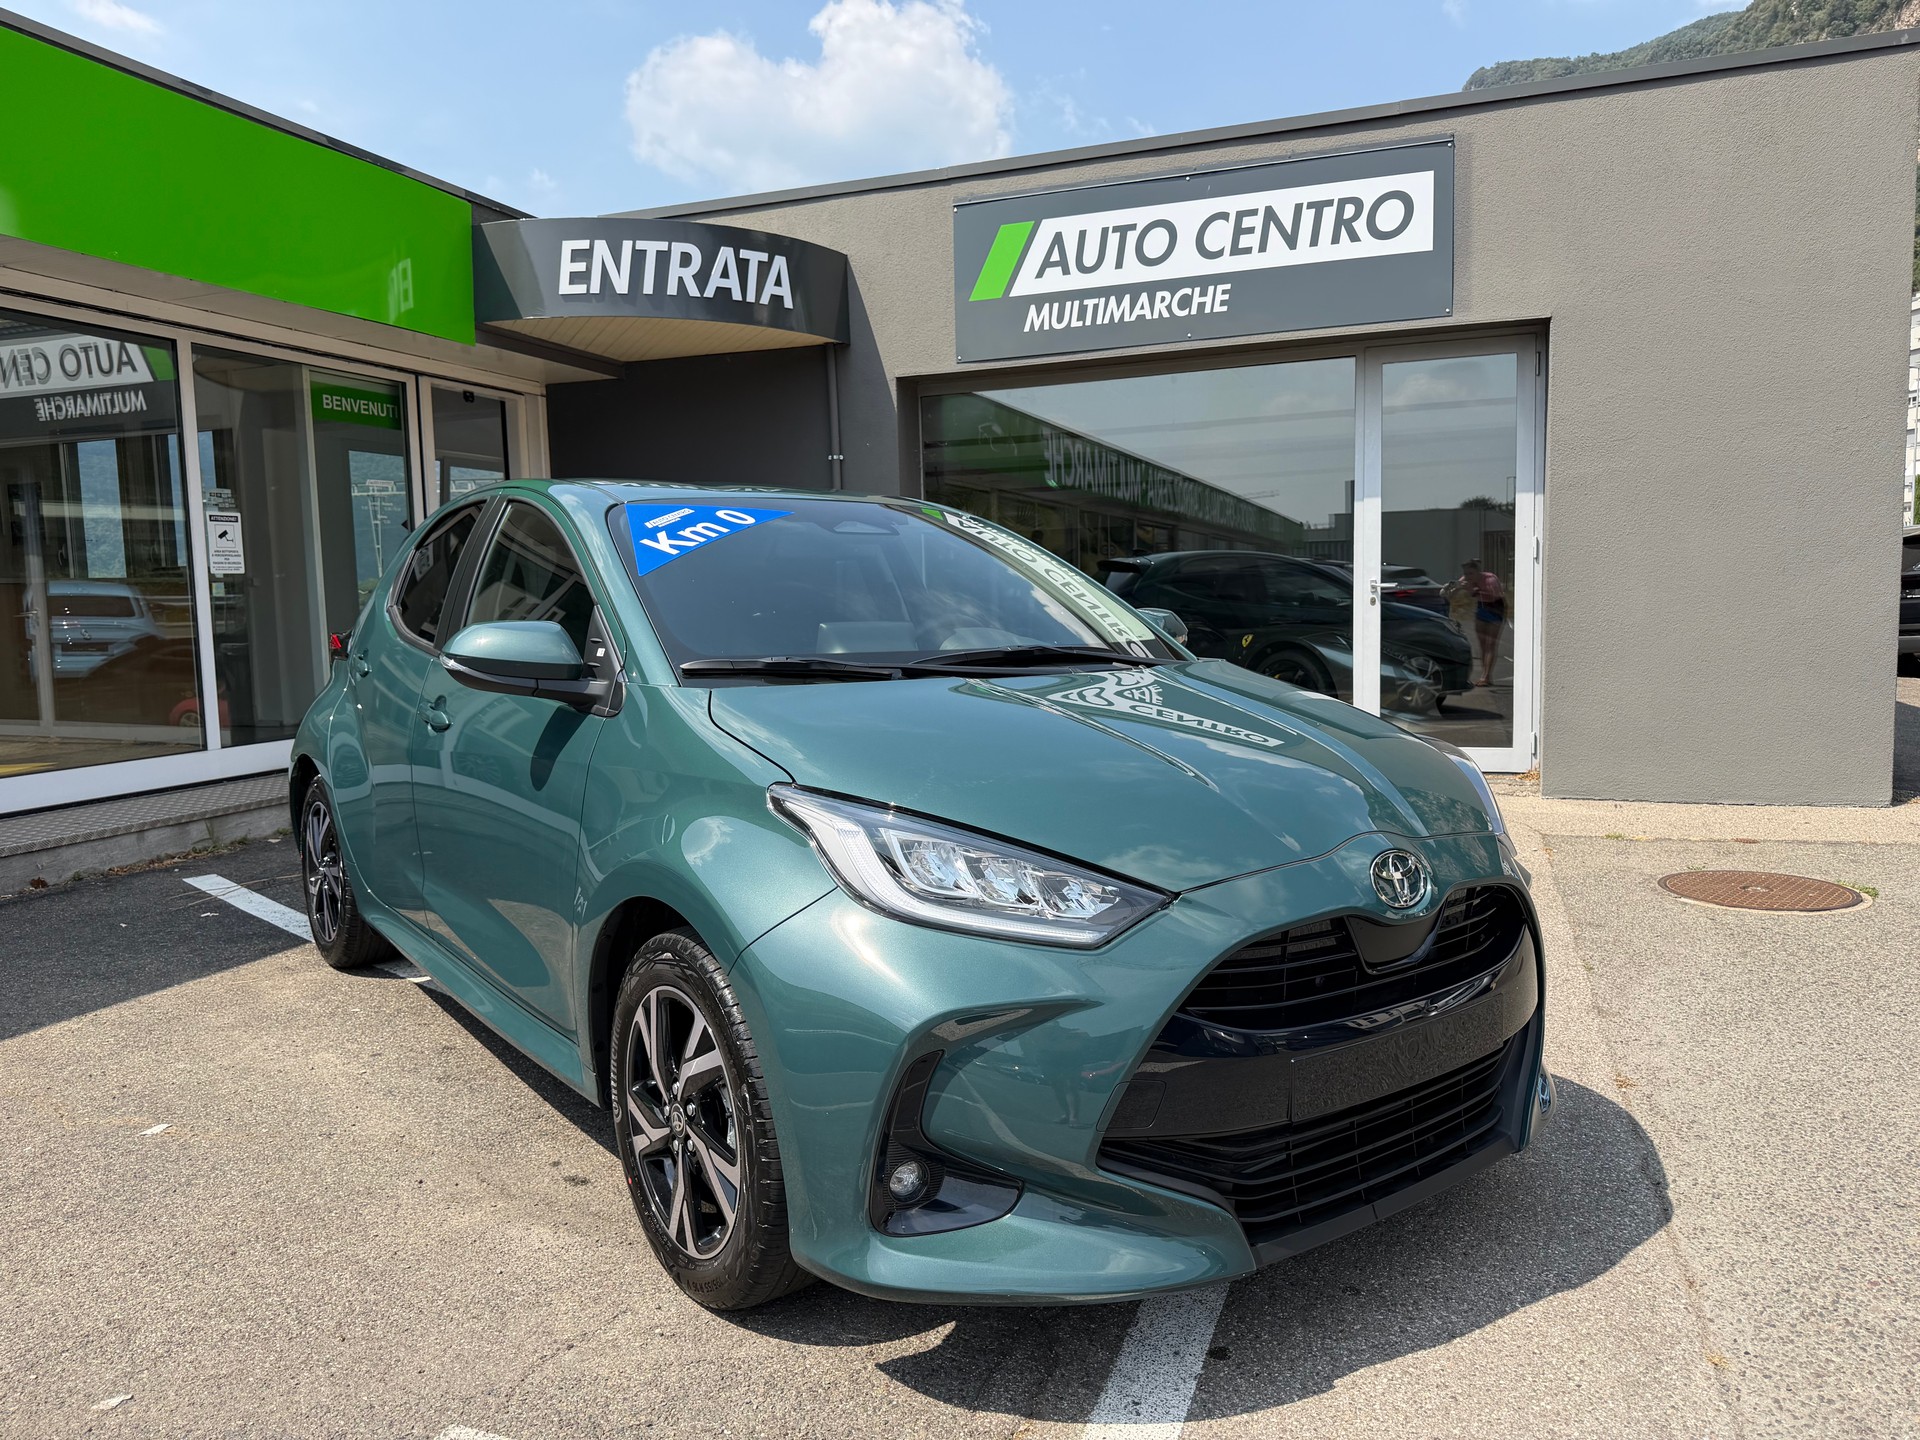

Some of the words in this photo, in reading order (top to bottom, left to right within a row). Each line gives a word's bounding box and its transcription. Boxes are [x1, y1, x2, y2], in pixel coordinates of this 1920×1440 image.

[1034, 218, 1178, 279] AUTO
[1194, 190, 1415, 260] CENTRO
[558, 239, 794, 310] ENTRATA
[1023, 283, 1232, 333] MULTIMARCHE
[322, 394, 399, 418] BENVENUTI
[639, 522, 731, 556] Km
[715, 509, 756, 525] 0
